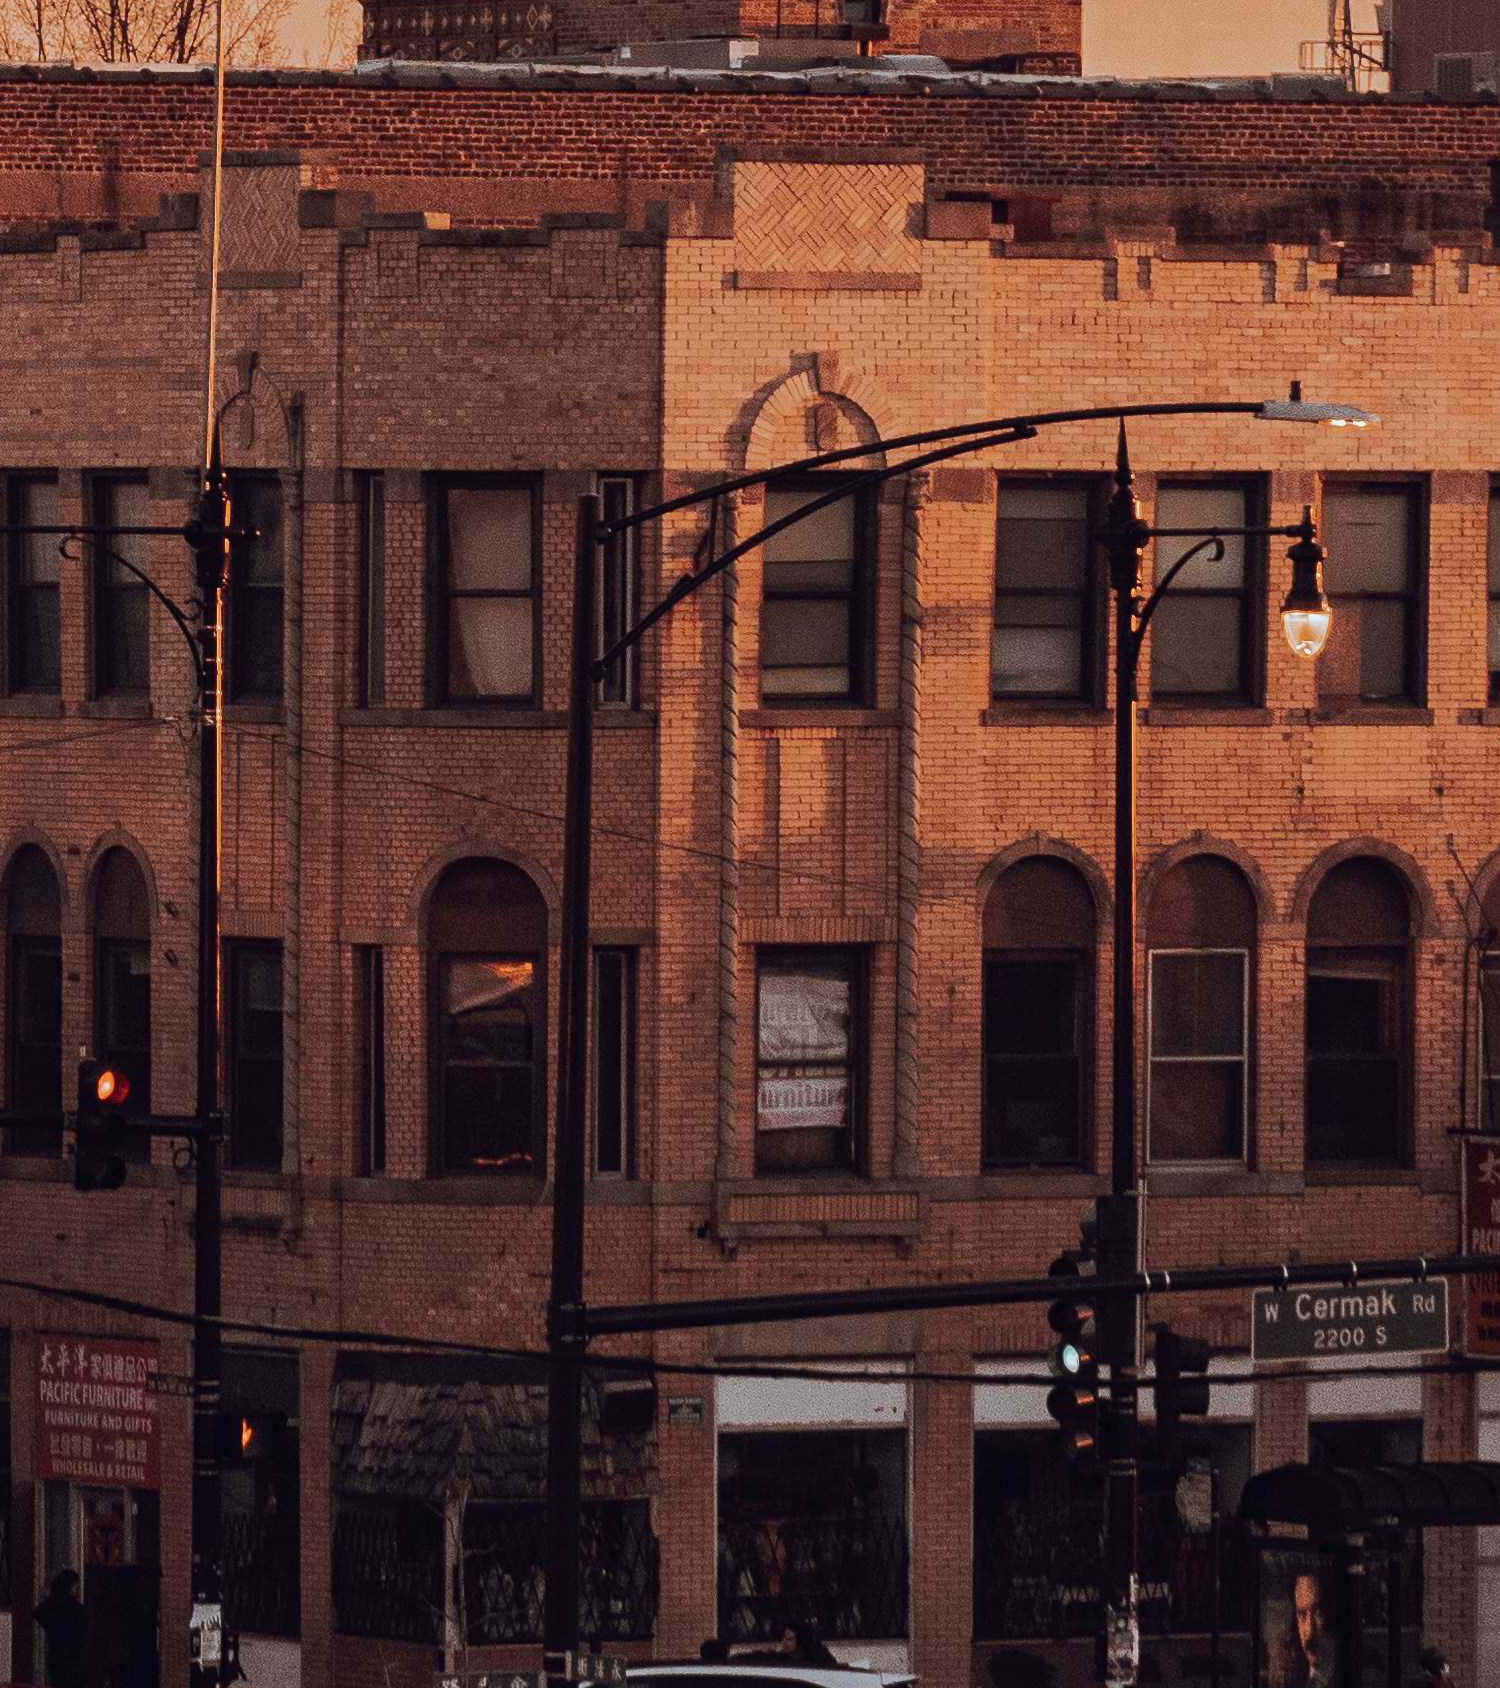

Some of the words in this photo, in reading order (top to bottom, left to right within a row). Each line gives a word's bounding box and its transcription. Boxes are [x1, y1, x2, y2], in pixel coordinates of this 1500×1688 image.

[1264, 1303, 1279, 1322] W
[1295, 1288, 1398, 1321] Cermak
[1412, 1293, 1436, 1314] Rd
[1312, 1327, 1365, 1349] 2200
[1375, 1326, 1388, 1346] S
[39, 1379, 81, 1405] PACIFIC
[82, 1383, 143, 1411] FURNITURE
[44, 1409, 100, 1429] FURNITURE
[101, 1414, 123, 1431] AND
[124, 1416, 153, 1434] GIFTS
[51, 1459, 105, 1478] WHOLESALE
[115, 1464, 146, 1481] RETAIL
